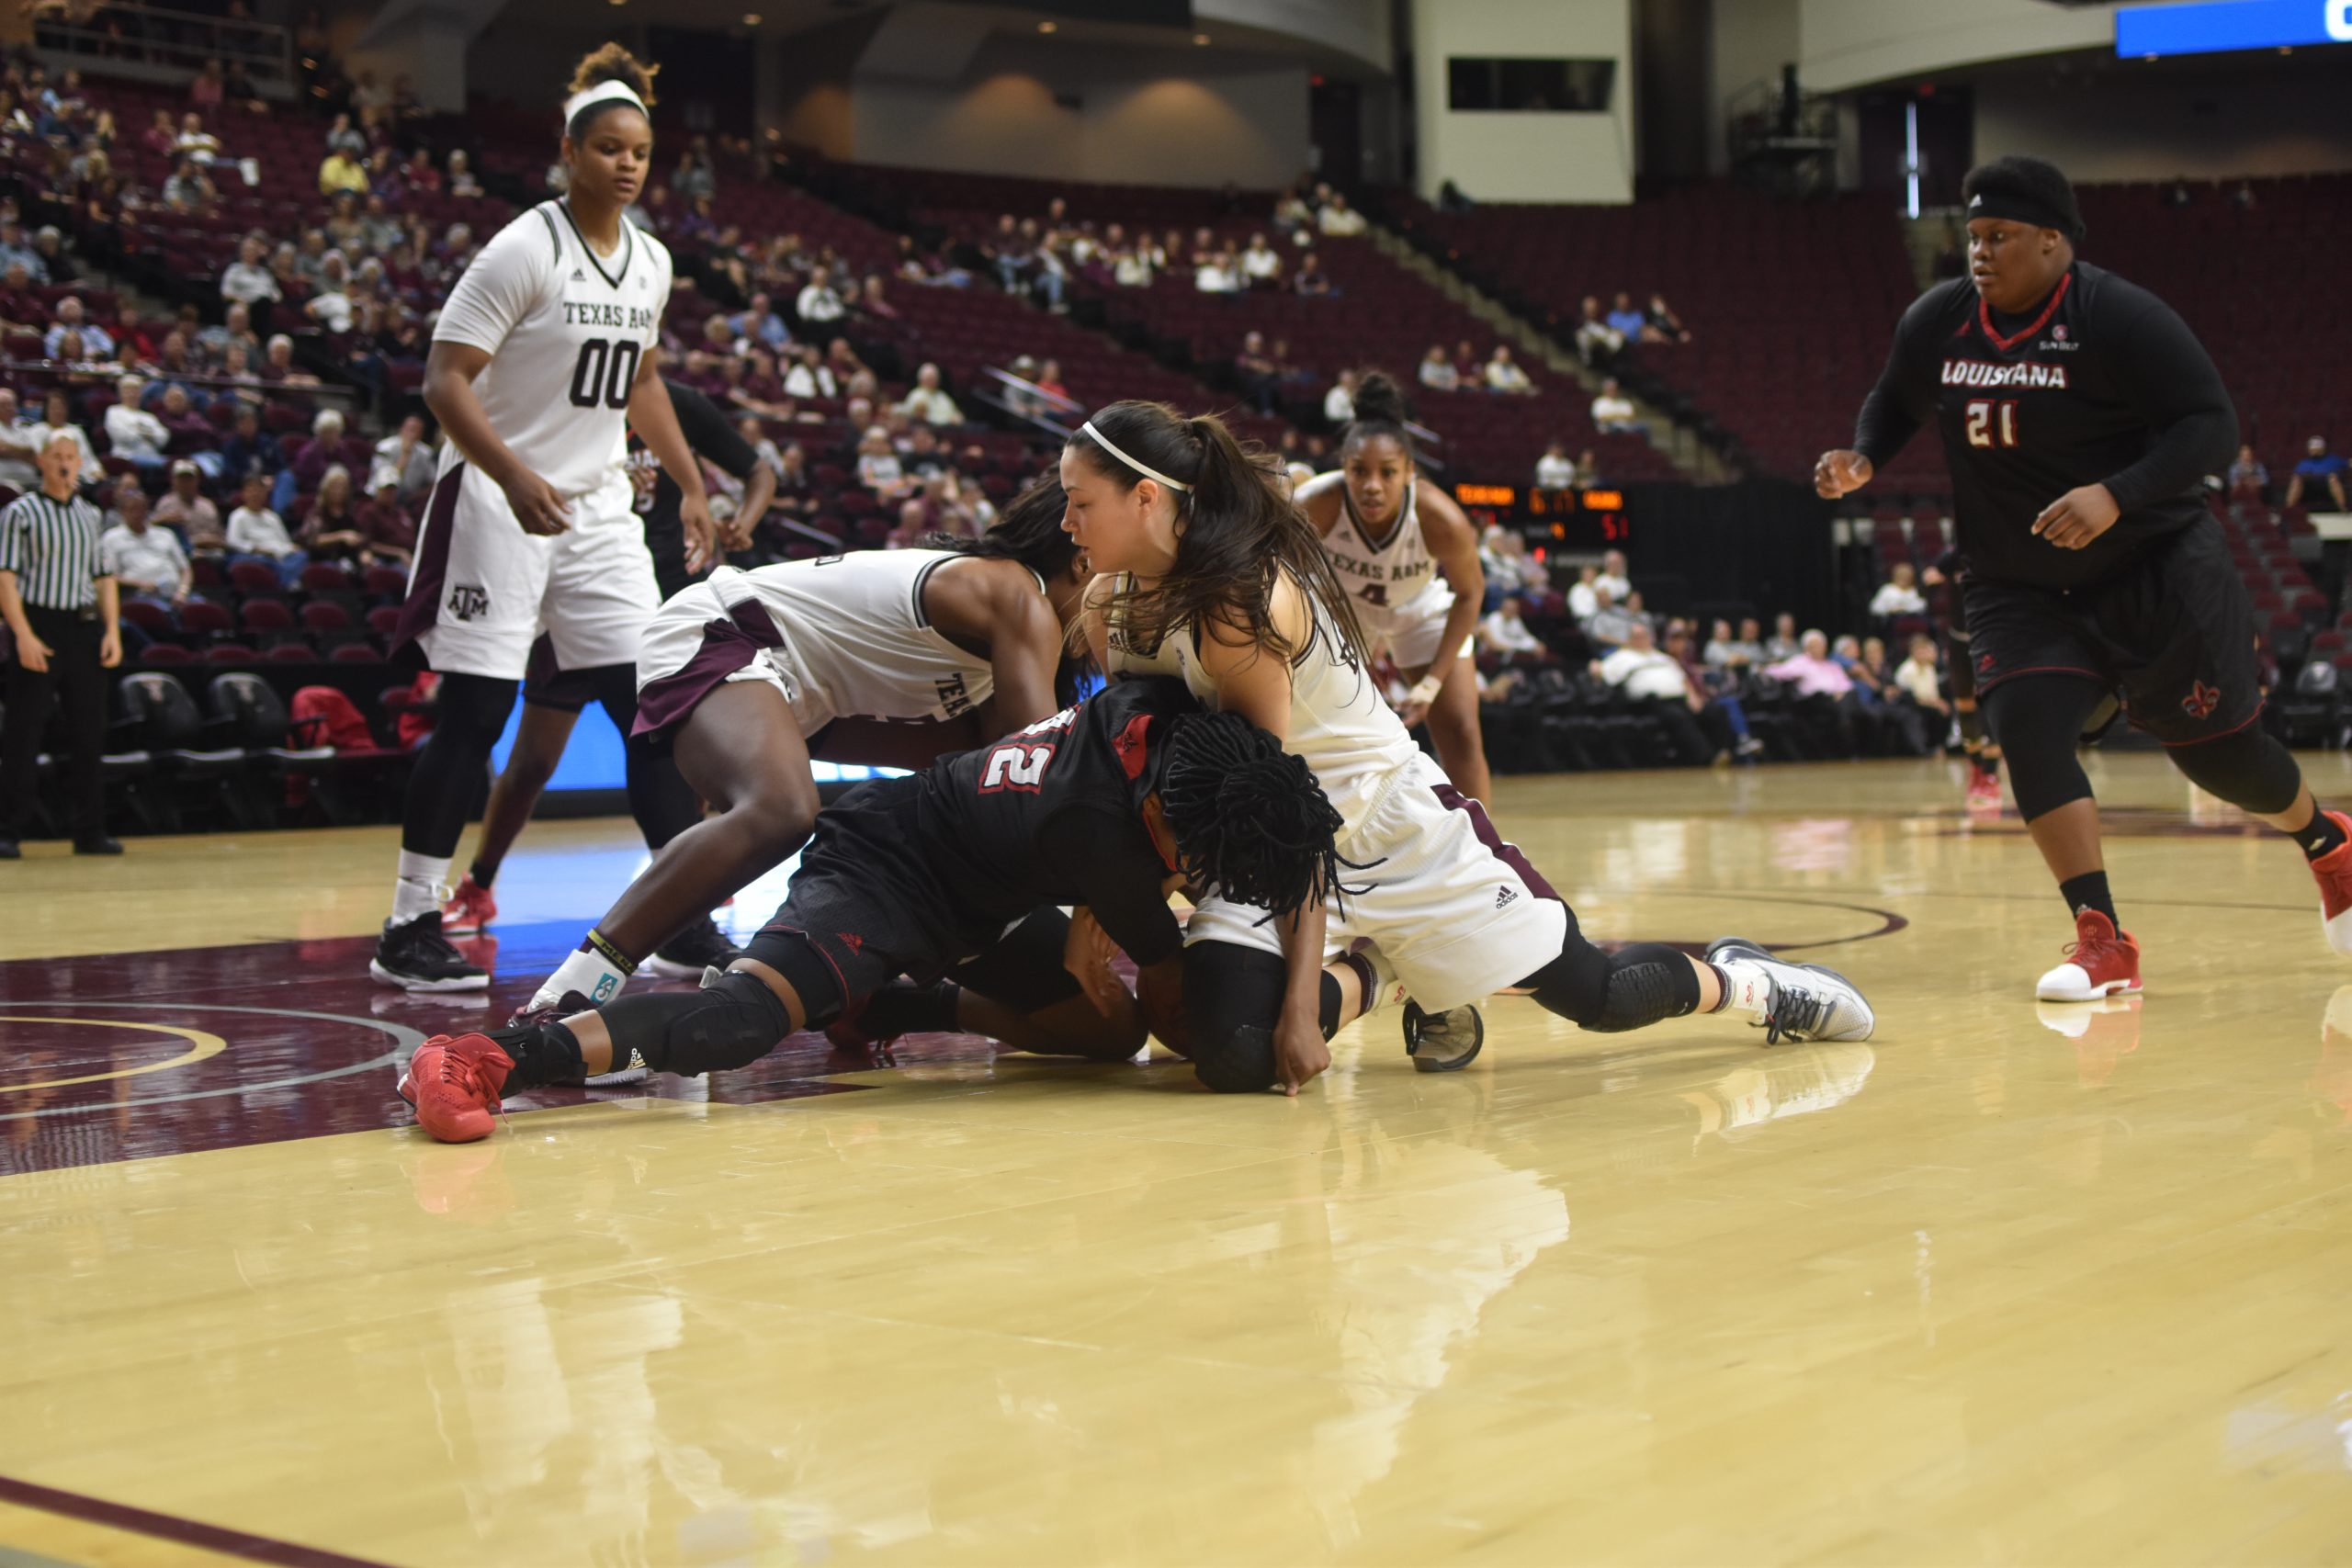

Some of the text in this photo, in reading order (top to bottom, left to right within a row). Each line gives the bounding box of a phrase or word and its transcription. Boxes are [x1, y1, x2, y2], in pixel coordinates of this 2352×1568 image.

[563, 301, 623, 327] TEXAS
[570, 338, 640, 409] 00
[1939, 358, 2068, 389] LOUISIANA
[1966, 400, 2017, 447] 21
[1326, 549, 1383, 580] EXAS
[1359, 582, 1390, 607] 4
[1496, 891, 1519, 909] adidas
